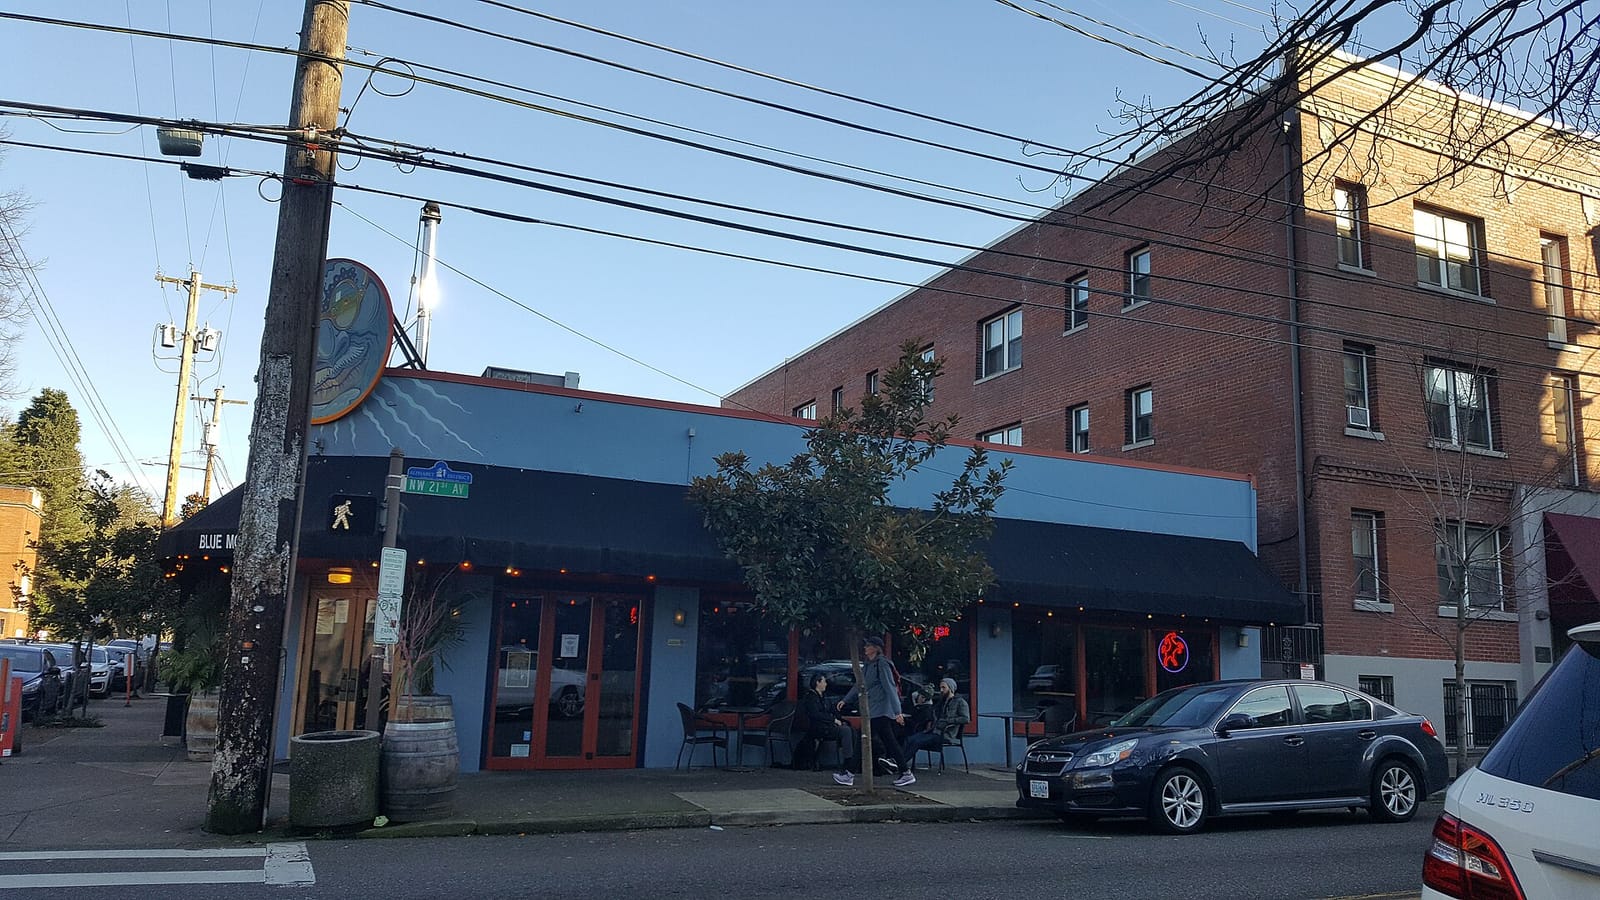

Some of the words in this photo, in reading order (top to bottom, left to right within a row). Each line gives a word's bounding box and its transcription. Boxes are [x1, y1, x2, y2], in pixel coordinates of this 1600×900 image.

[409, 480, 426, 491] NW
[452, 483, 464, 495] AV
[199, 534, 222, 549] BLUE
[1498, 797, 1534, 813] 350
